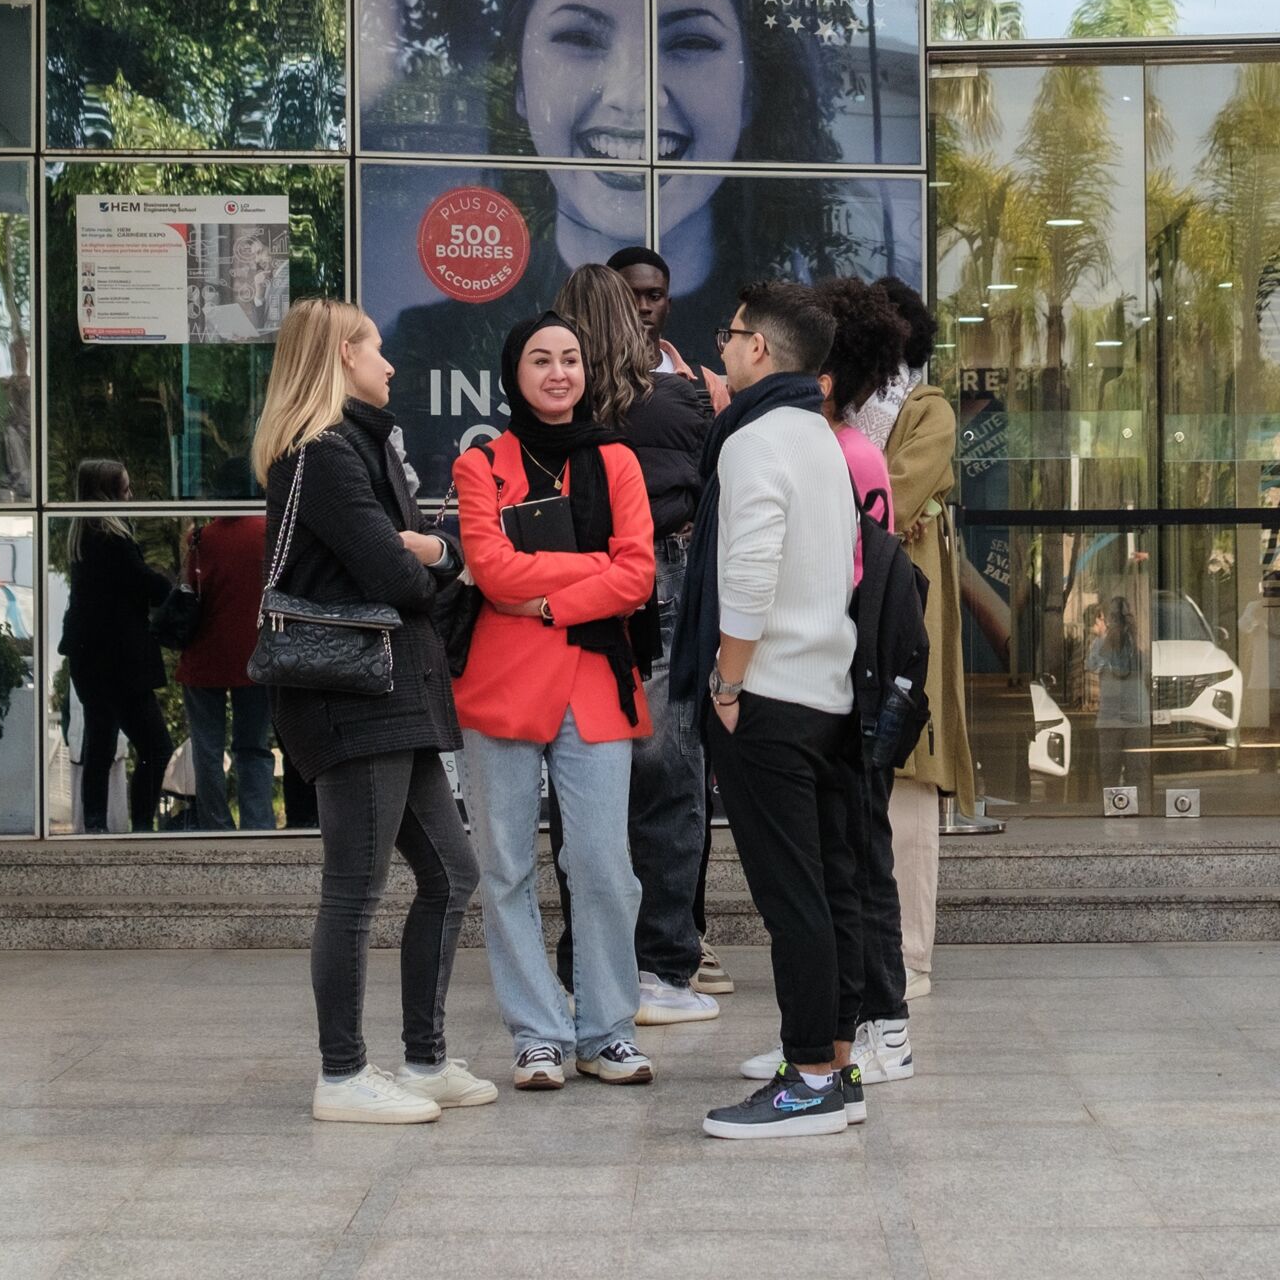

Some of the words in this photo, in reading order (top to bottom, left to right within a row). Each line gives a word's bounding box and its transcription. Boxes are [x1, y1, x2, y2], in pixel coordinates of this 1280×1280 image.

[111, 202, 140, 212] HEM
[440, 197, 481, 220] PLUS
[486, 201, 509, 222] DE
[450, 224, 501, 245] 500
[435, 245, 514, 259] BOURSES
[437, 264, 512, 290] ACCORDÉES
